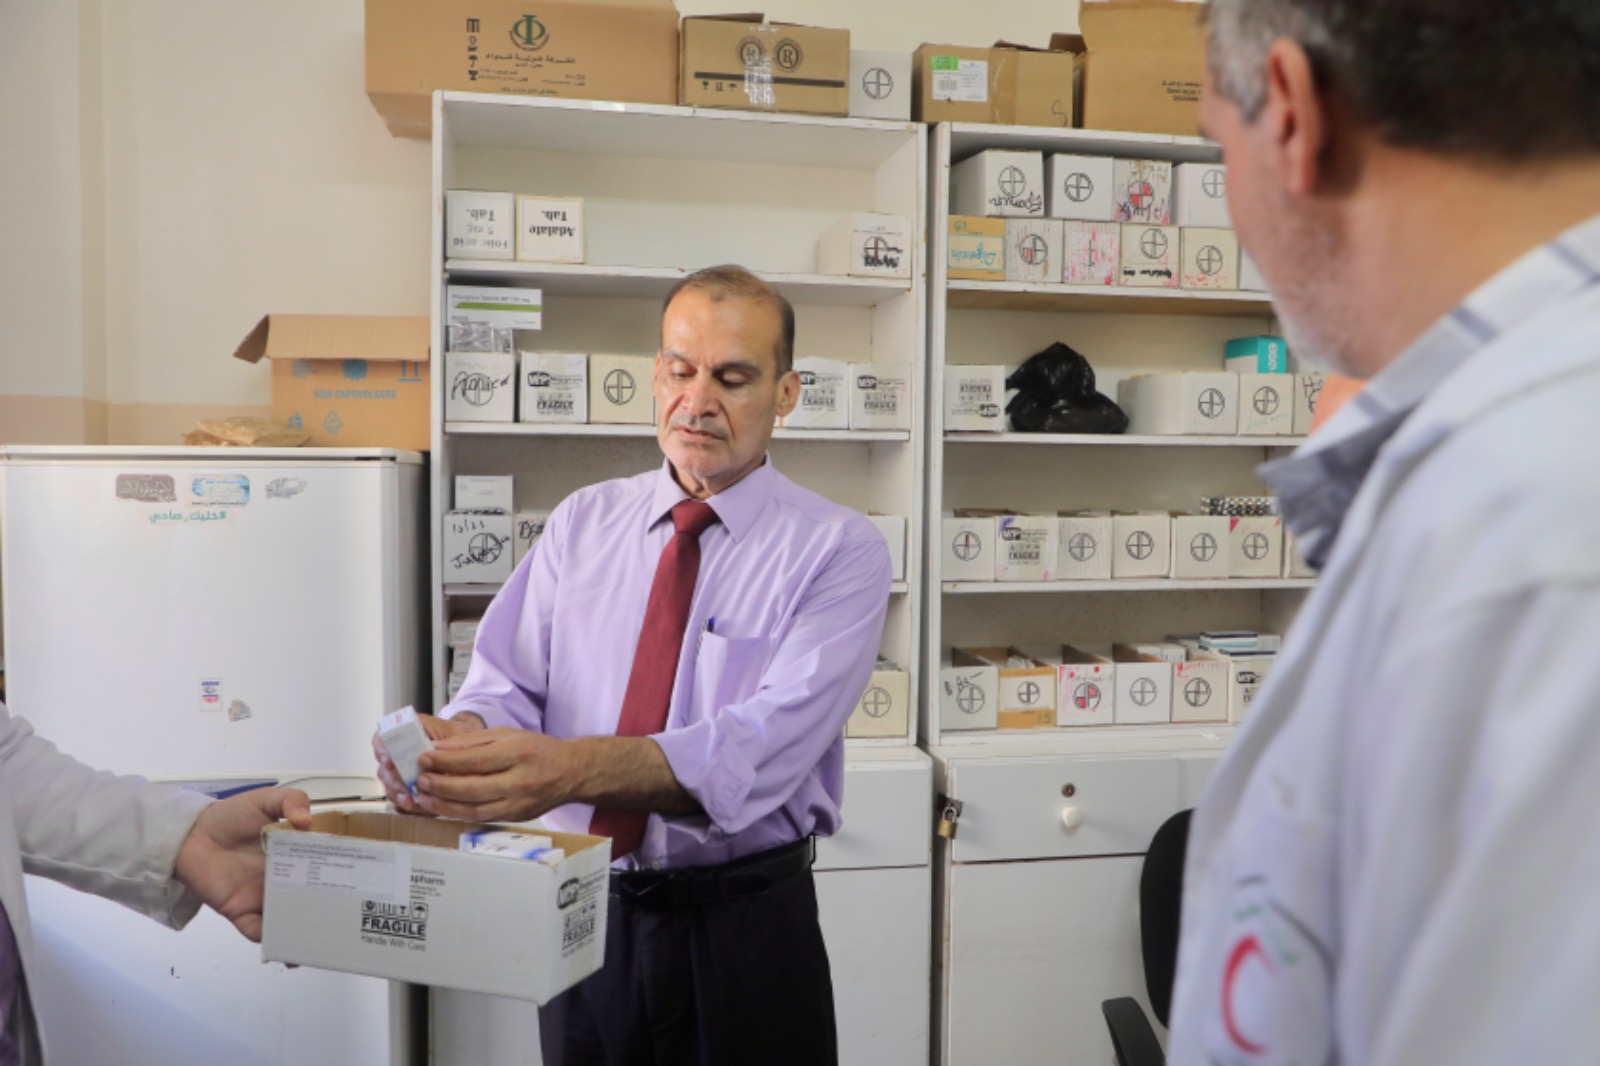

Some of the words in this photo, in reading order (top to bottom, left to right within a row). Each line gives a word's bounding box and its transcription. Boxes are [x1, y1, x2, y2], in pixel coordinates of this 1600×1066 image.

[361, 916, 426, 937] FRAGILE
[361, 934, 387, 946] Handle
[389, 937, 406, 949] With
[408, 940, 426, 952] Care
